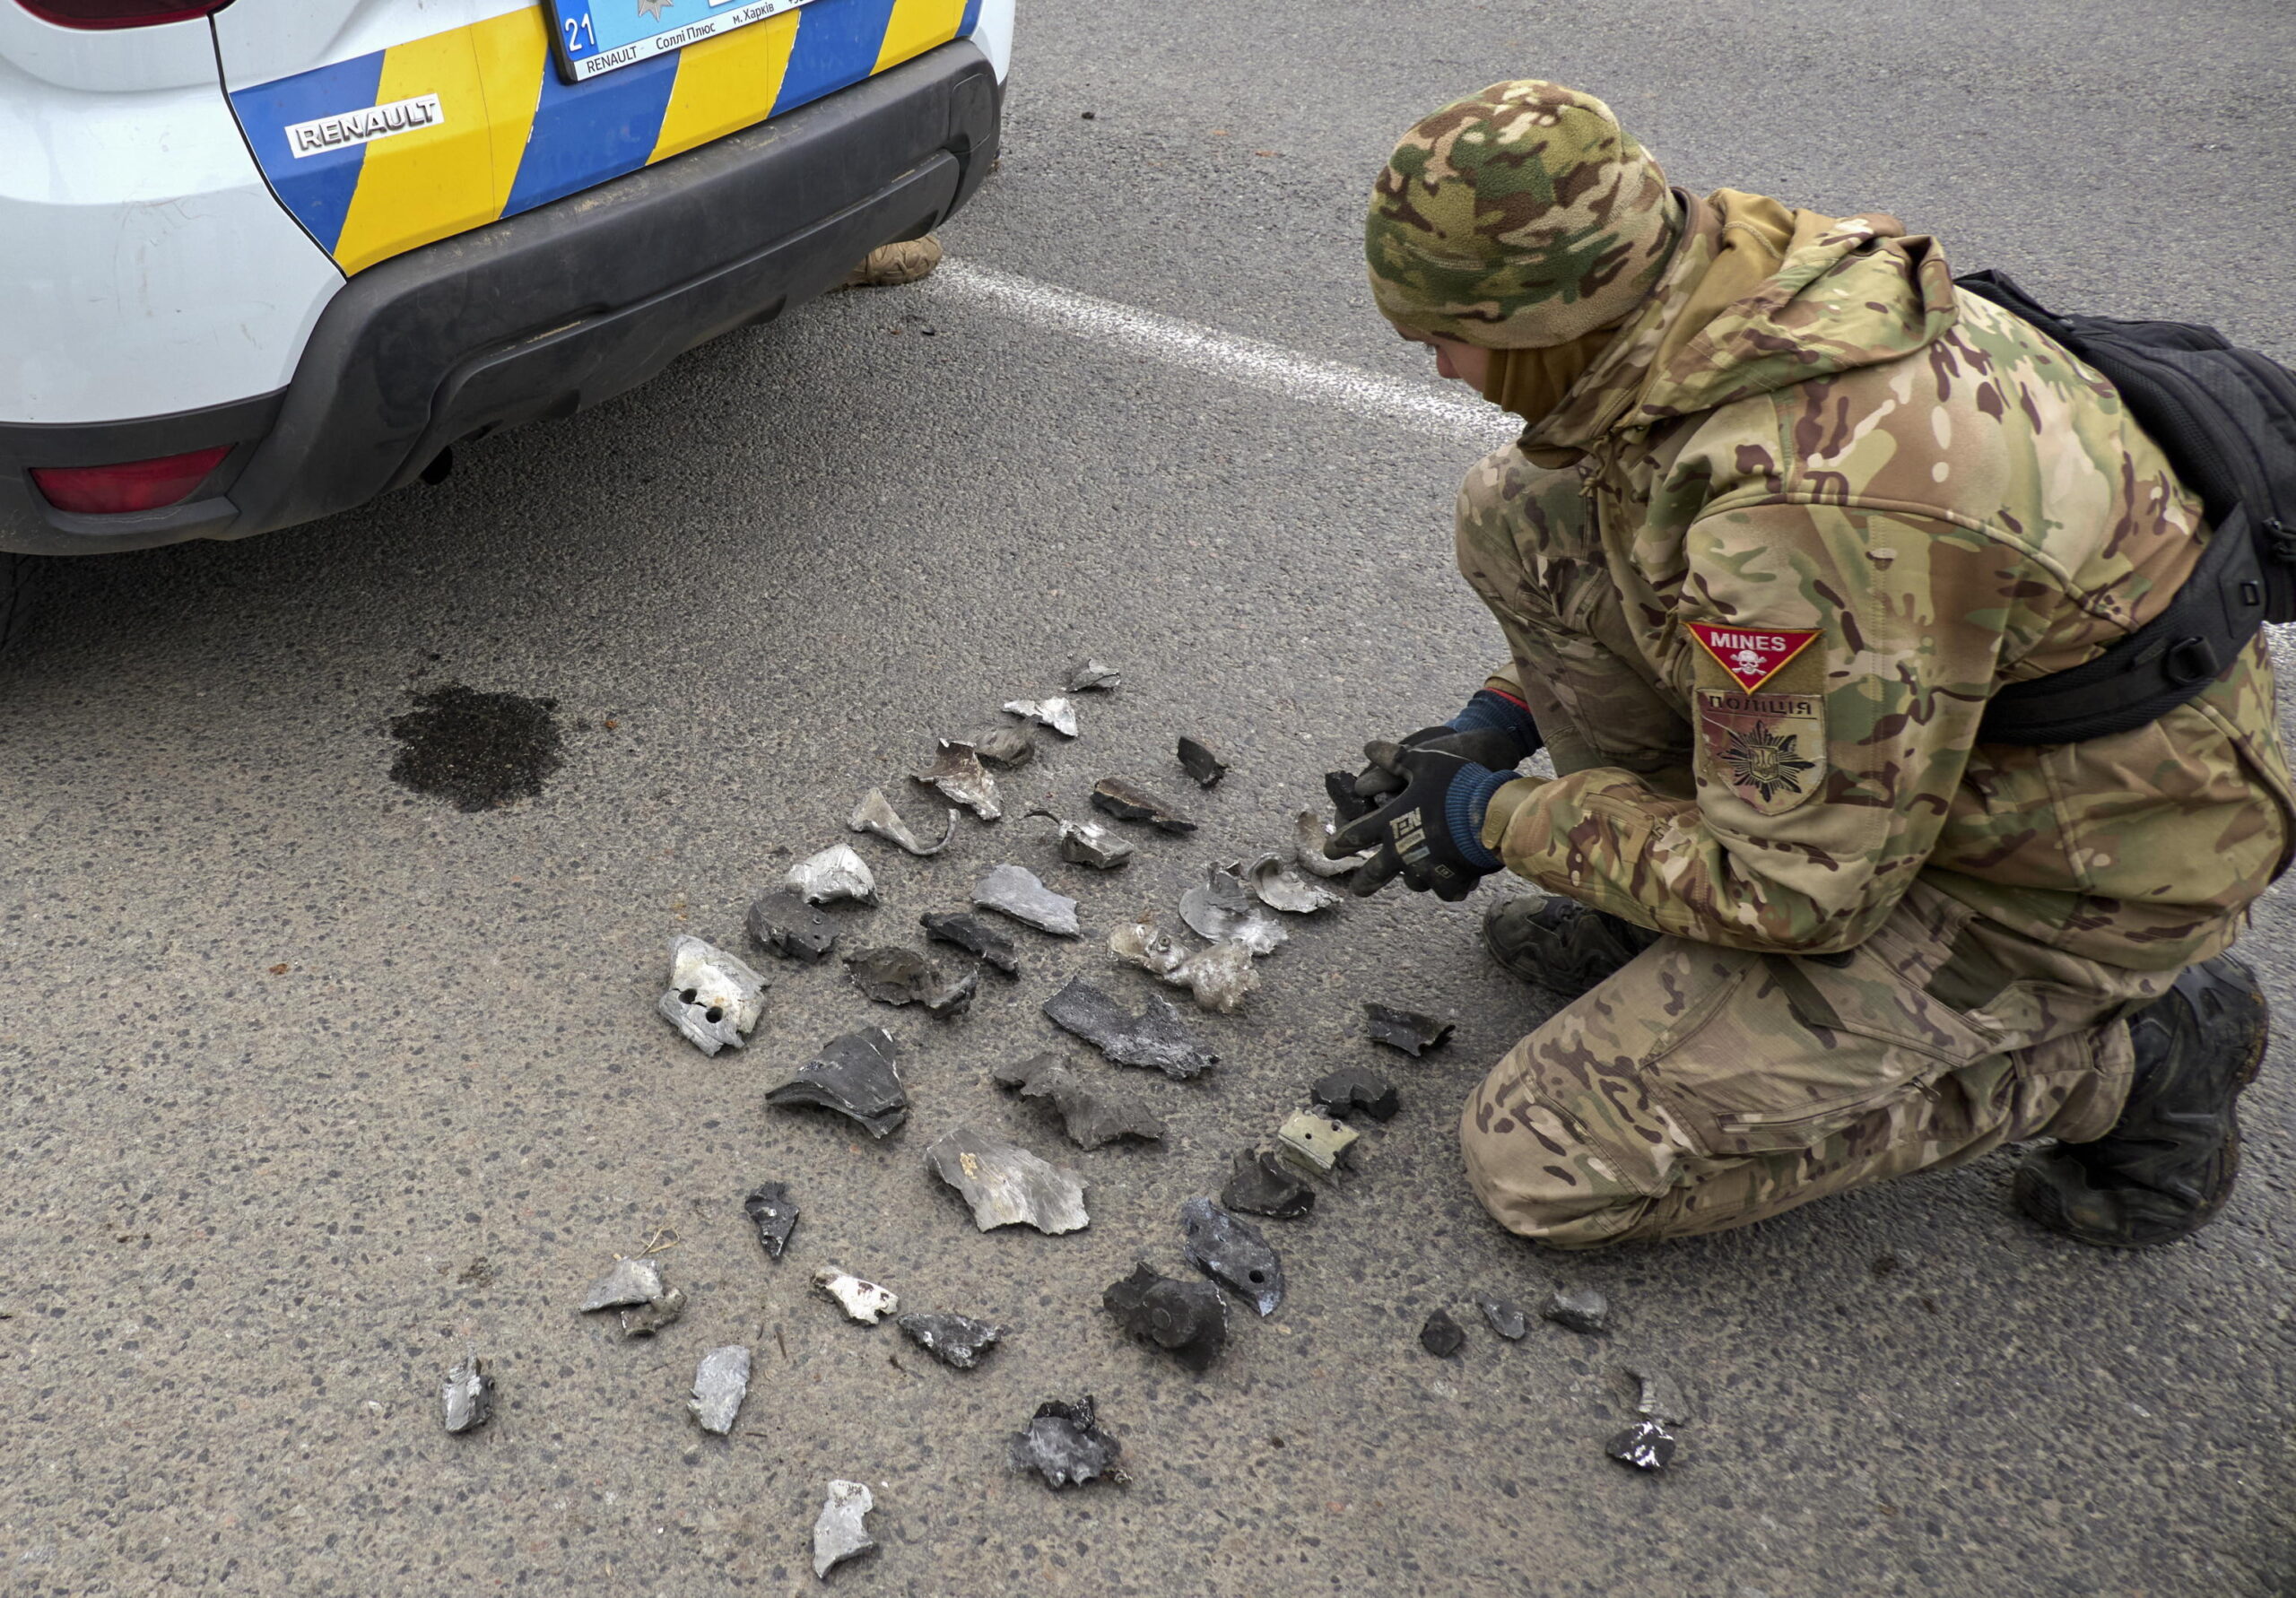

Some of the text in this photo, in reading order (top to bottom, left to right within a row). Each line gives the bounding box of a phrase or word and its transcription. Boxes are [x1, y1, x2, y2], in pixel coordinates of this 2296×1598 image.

[565, 13, 595, 52] 21
[587, 3, 775, 74] RENAULT Соллі Плюс м. Харків
[296, 99, 435, 151] RENAULT
[1710, 631, 1787, 652] MINES
[1709, 695, 1812, 715] ПОЛІЦІЯ
